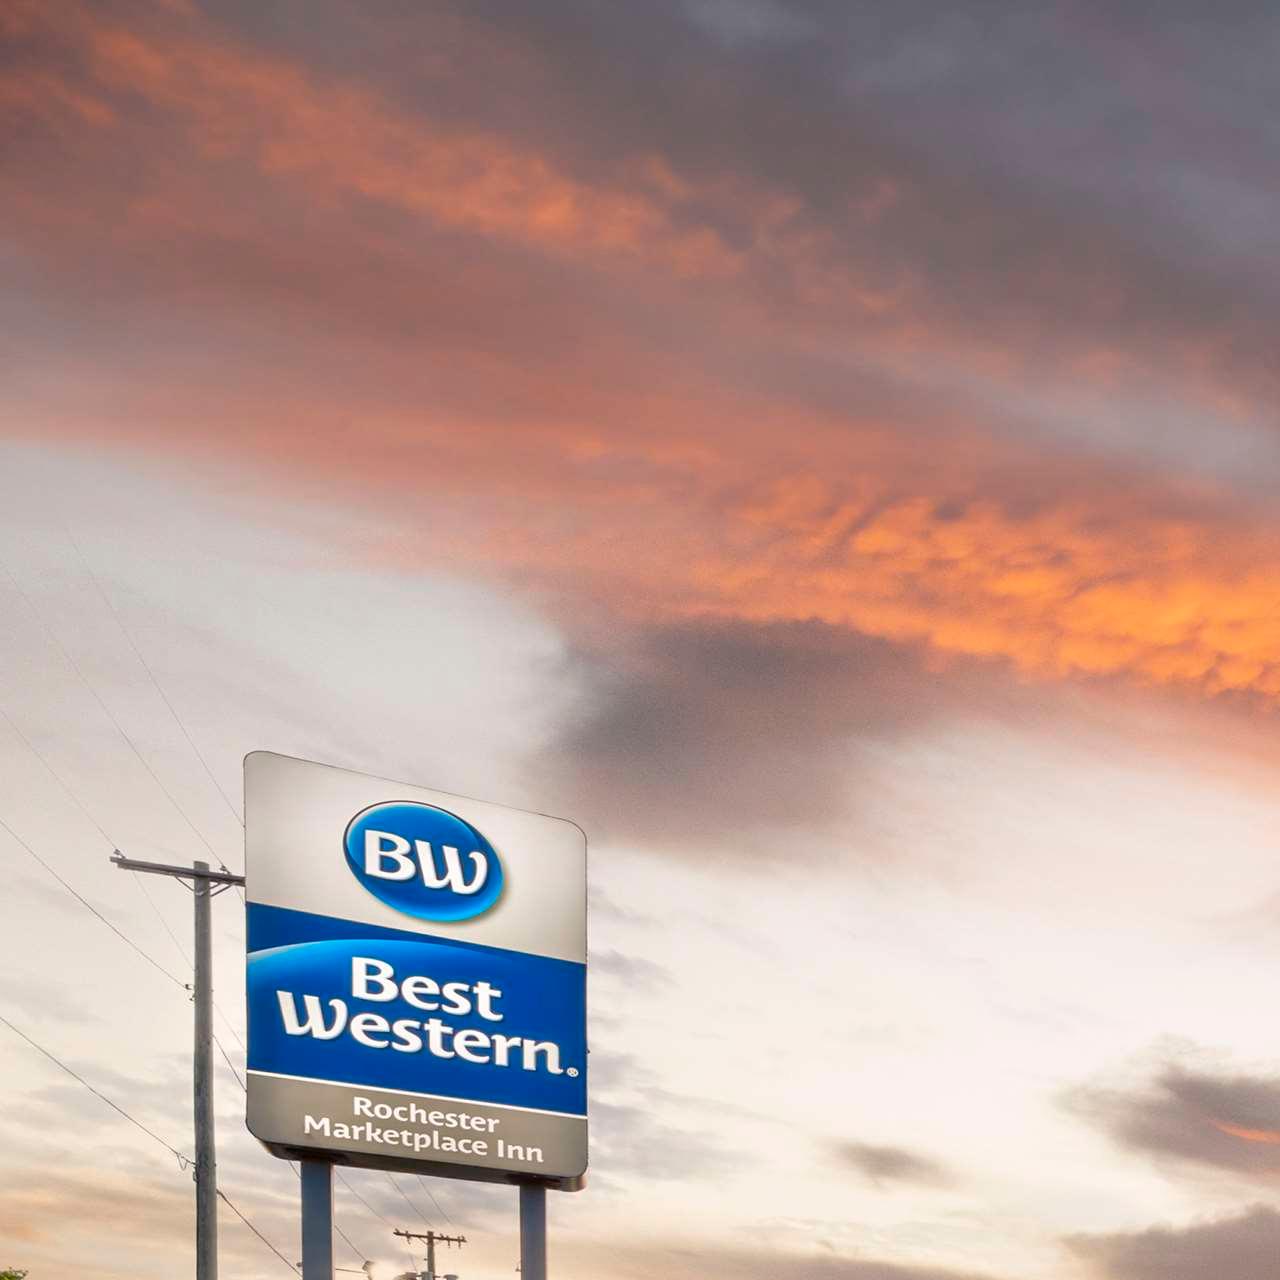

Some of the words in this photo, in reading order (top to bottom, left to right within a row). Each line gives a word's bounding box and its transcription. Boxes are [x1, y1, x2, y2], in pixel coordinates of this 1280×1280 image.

[365, 829, 488, 894] BW
[351, 956, 503, 1021] Best
[304, 1114, 488, 1156] Marketplace
[497, 1139, 544, 1163] Inn
[353, 1096, 500, 1133] Rochester
